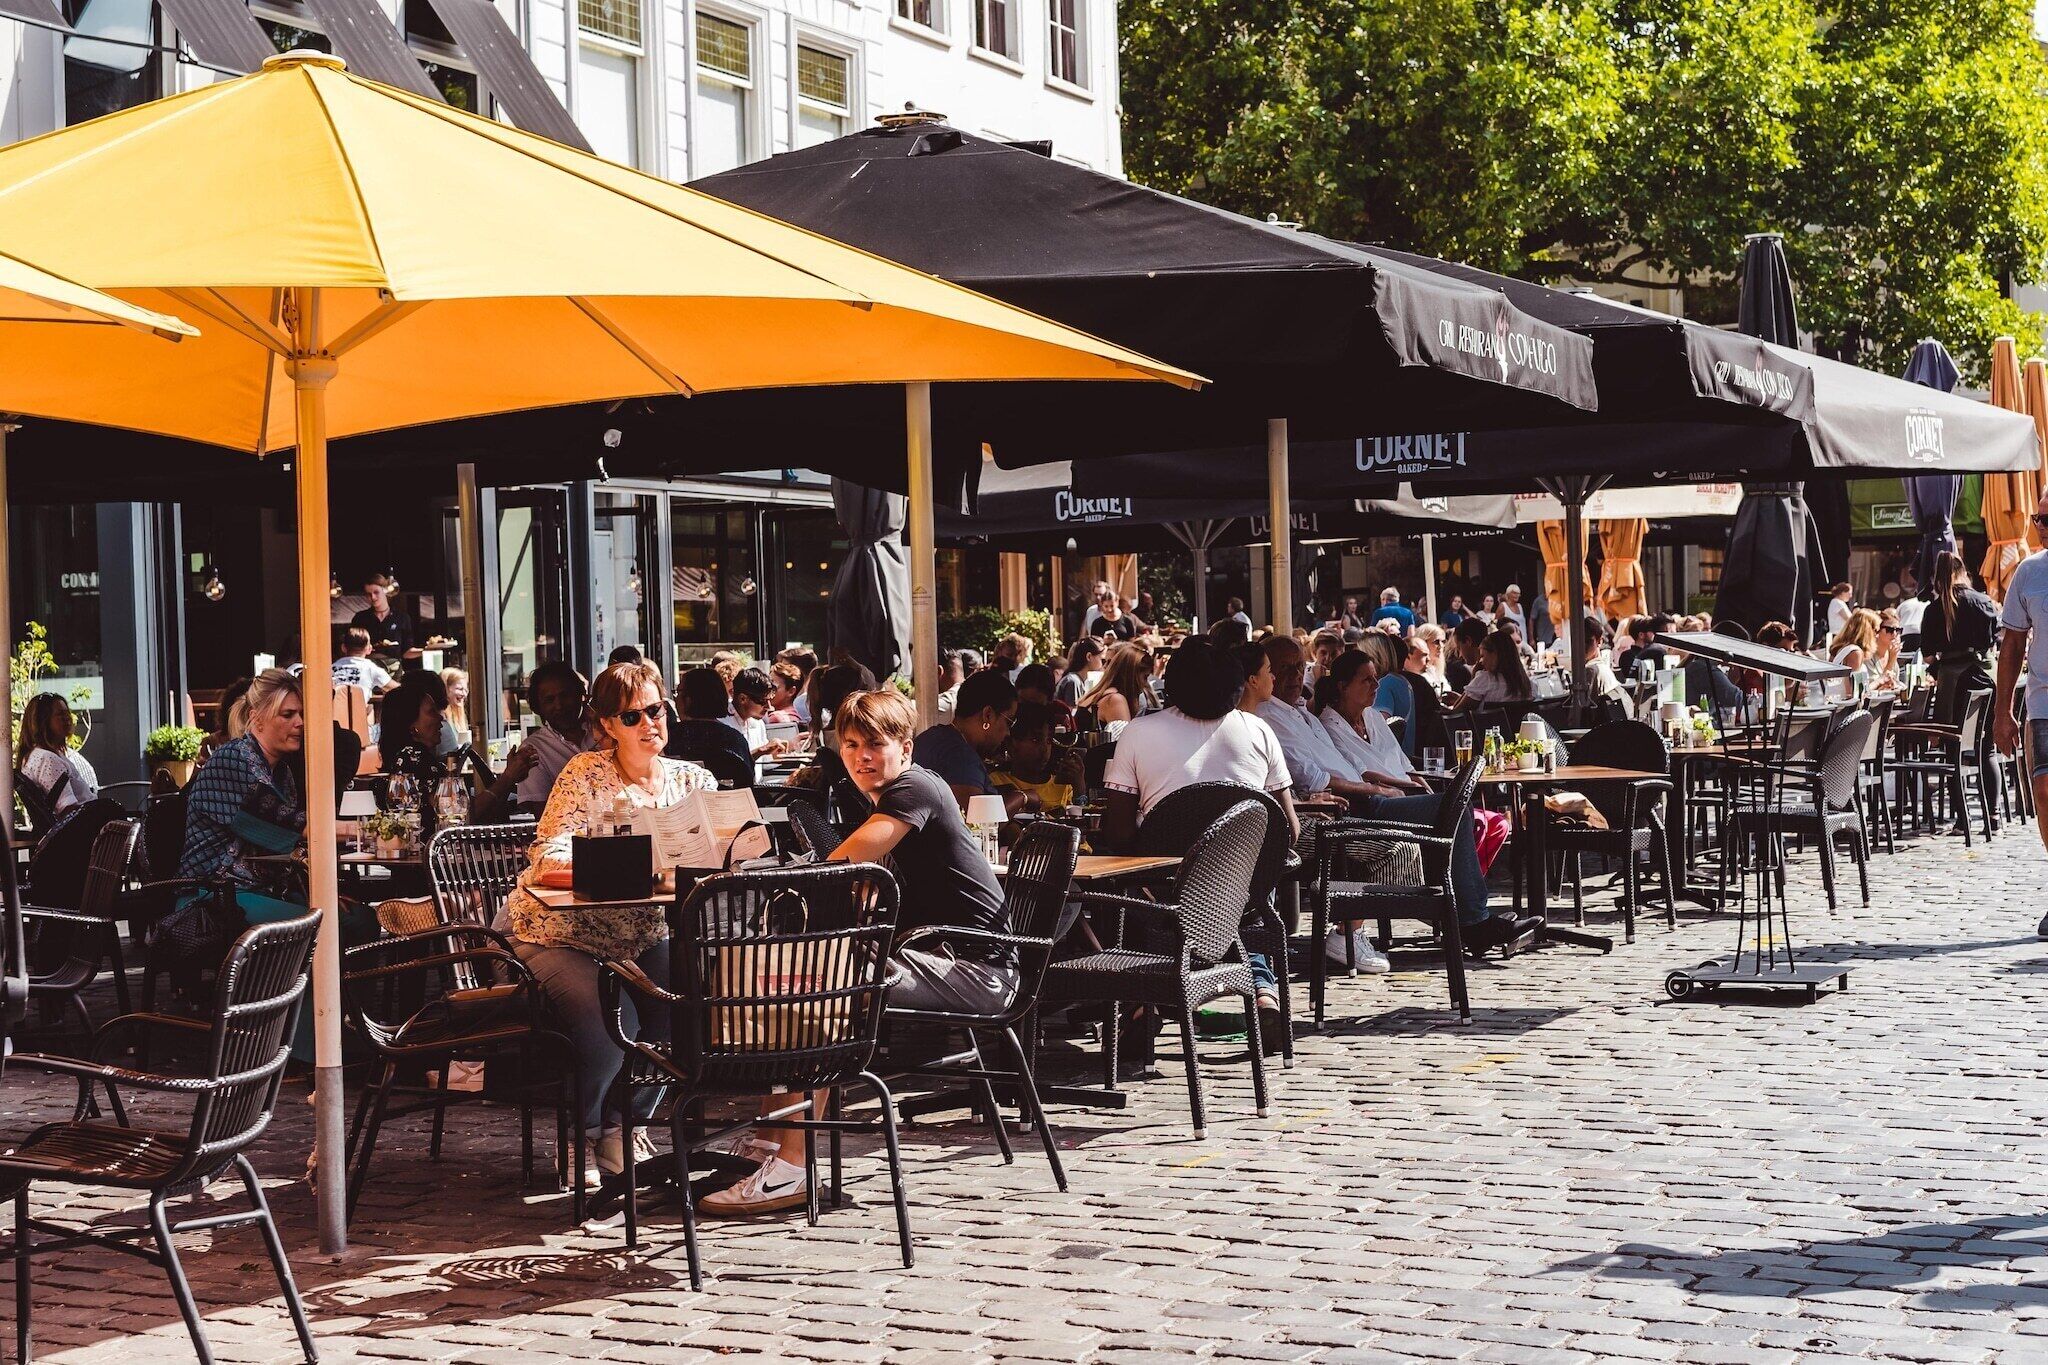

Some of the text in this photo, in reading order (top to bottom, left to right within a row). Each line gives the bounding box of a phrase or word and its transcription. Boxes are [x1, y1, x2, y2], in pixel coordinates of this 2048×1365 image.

[1356, 432, 1470, 471] CORNET
[1905, 415, 1944, 457] CORNET
[1397, 464, 1422, 474] OAKED
[1055, 491, 1132, 521] CORNET
